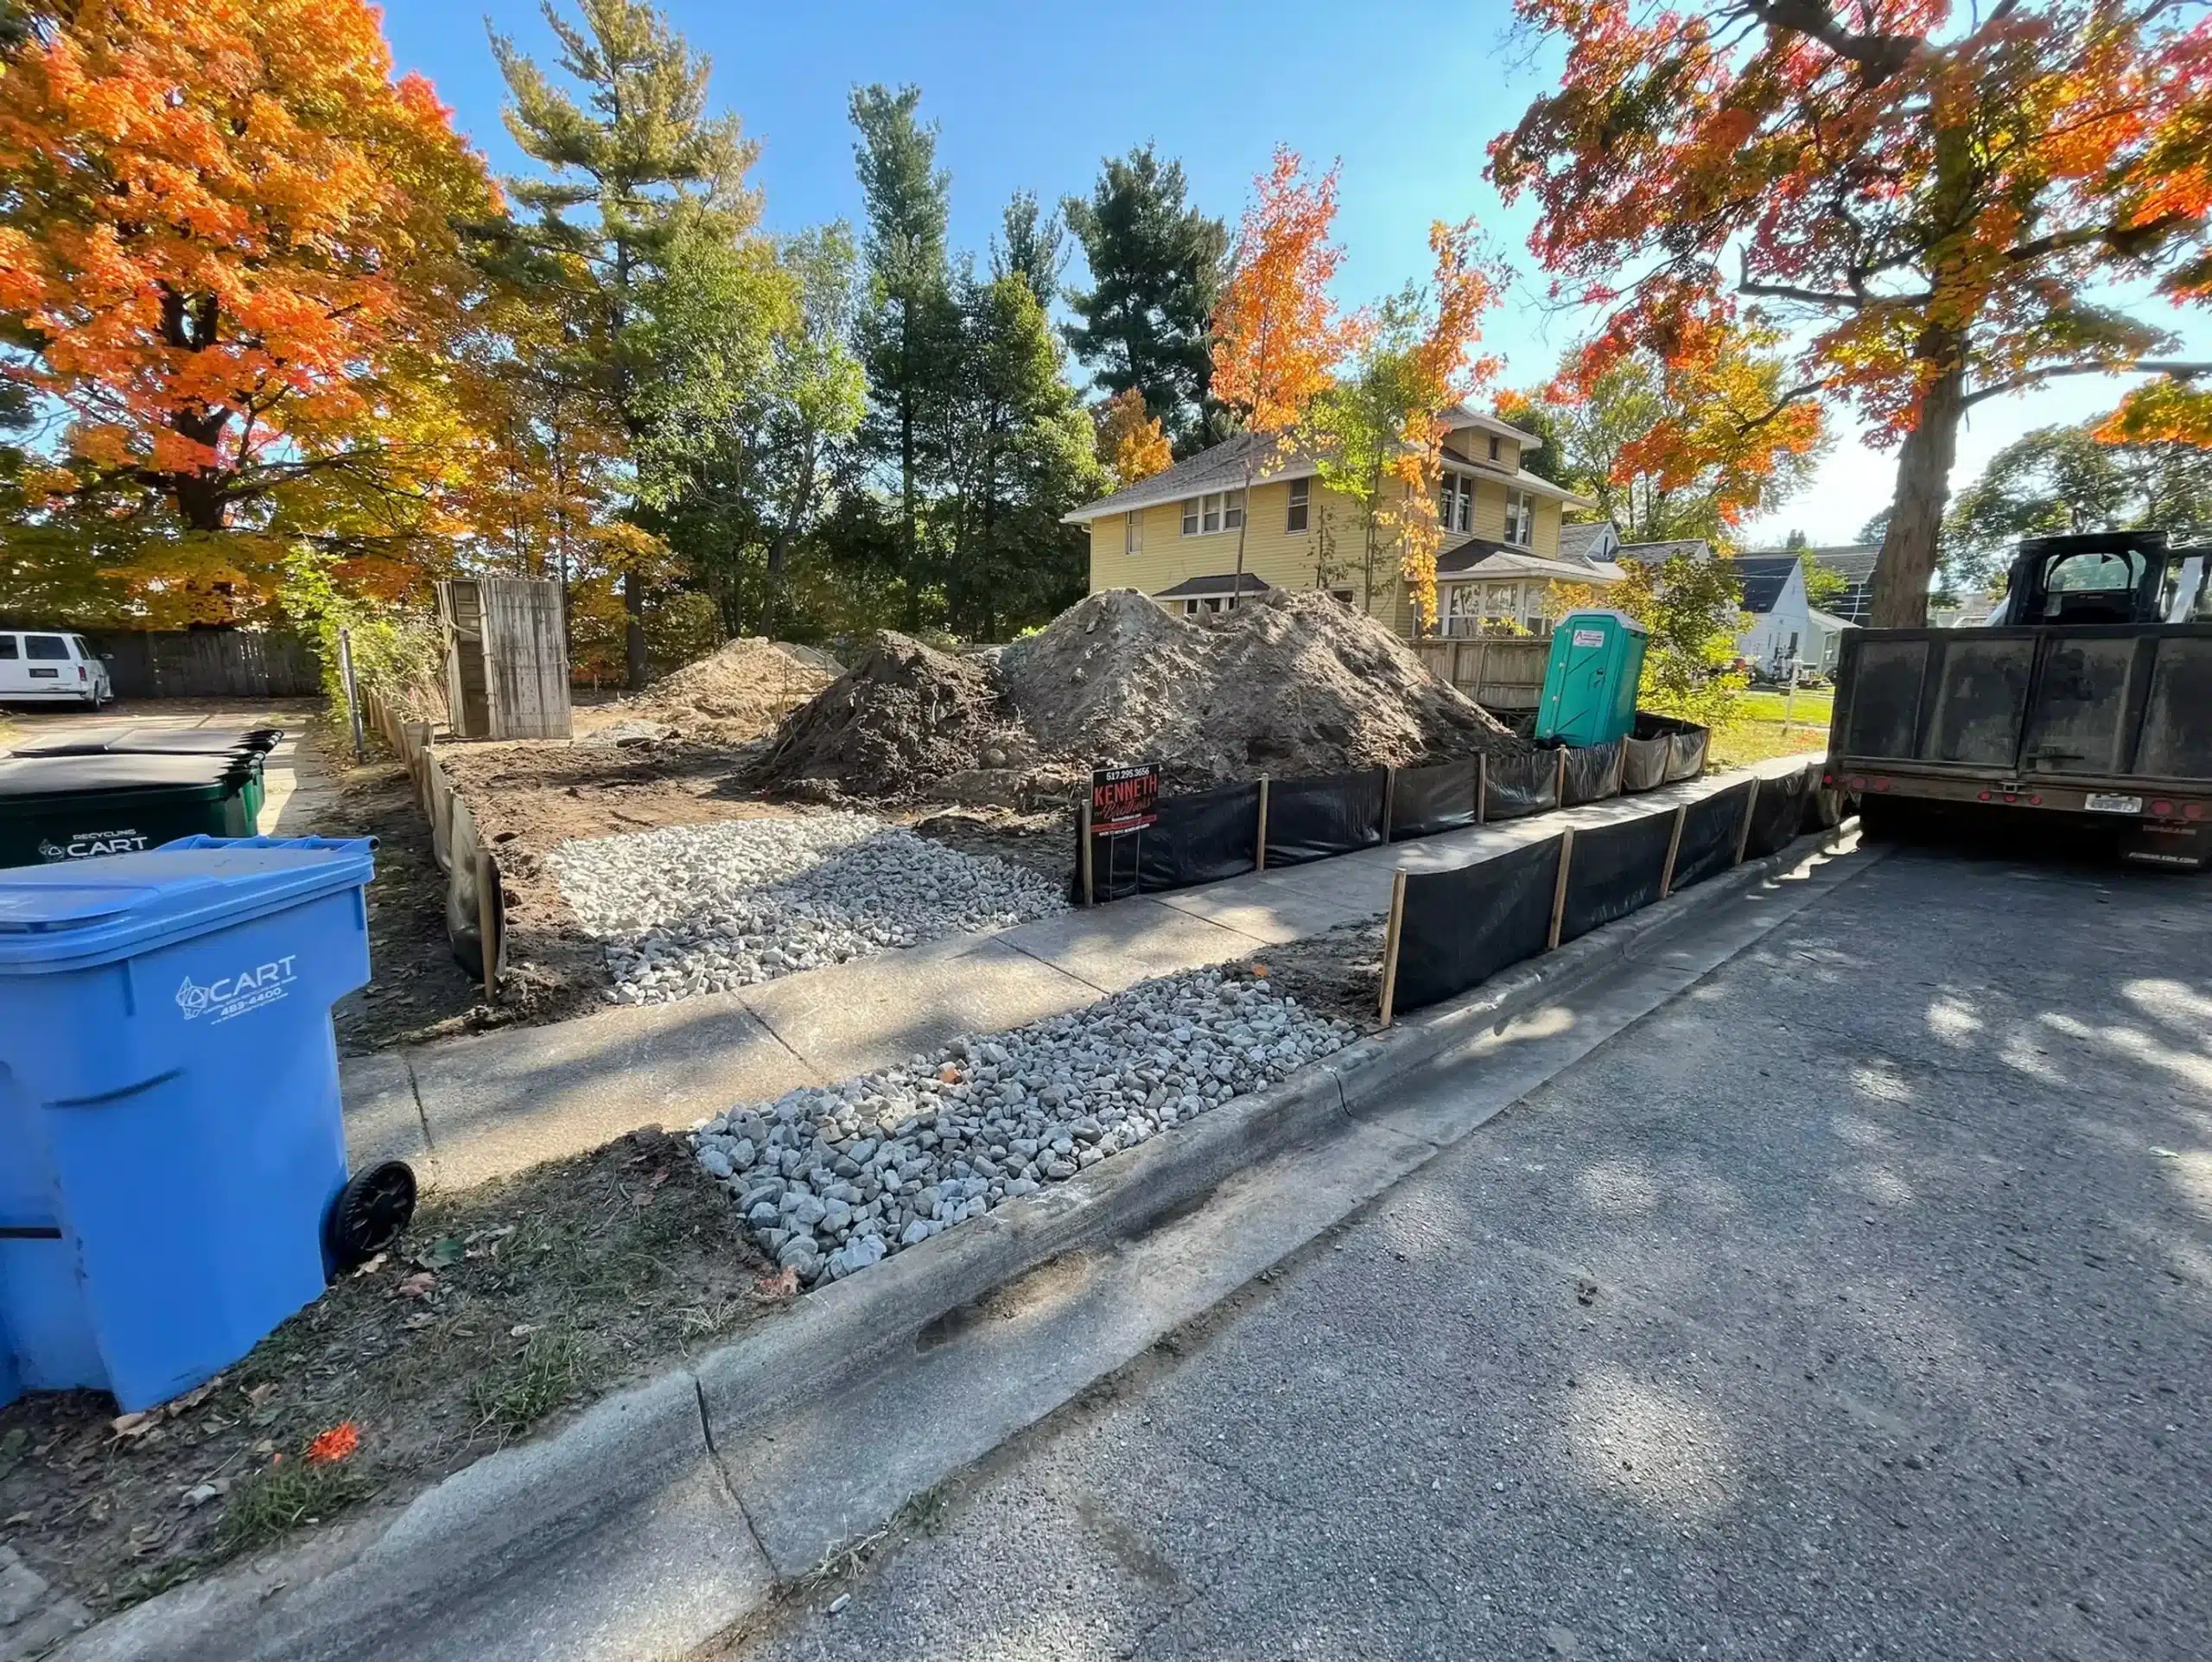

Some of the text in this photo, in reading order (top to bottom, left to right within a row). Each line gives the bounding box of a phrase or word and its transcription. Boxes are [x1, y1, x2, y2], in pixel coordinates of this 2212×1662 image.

[1094, 774, 1157, 806] KENNETH
[67, 837, 148, 856] CART
[73, 829, 137, 840] RECYCLING
[210, 954, 296, 1002] CART
